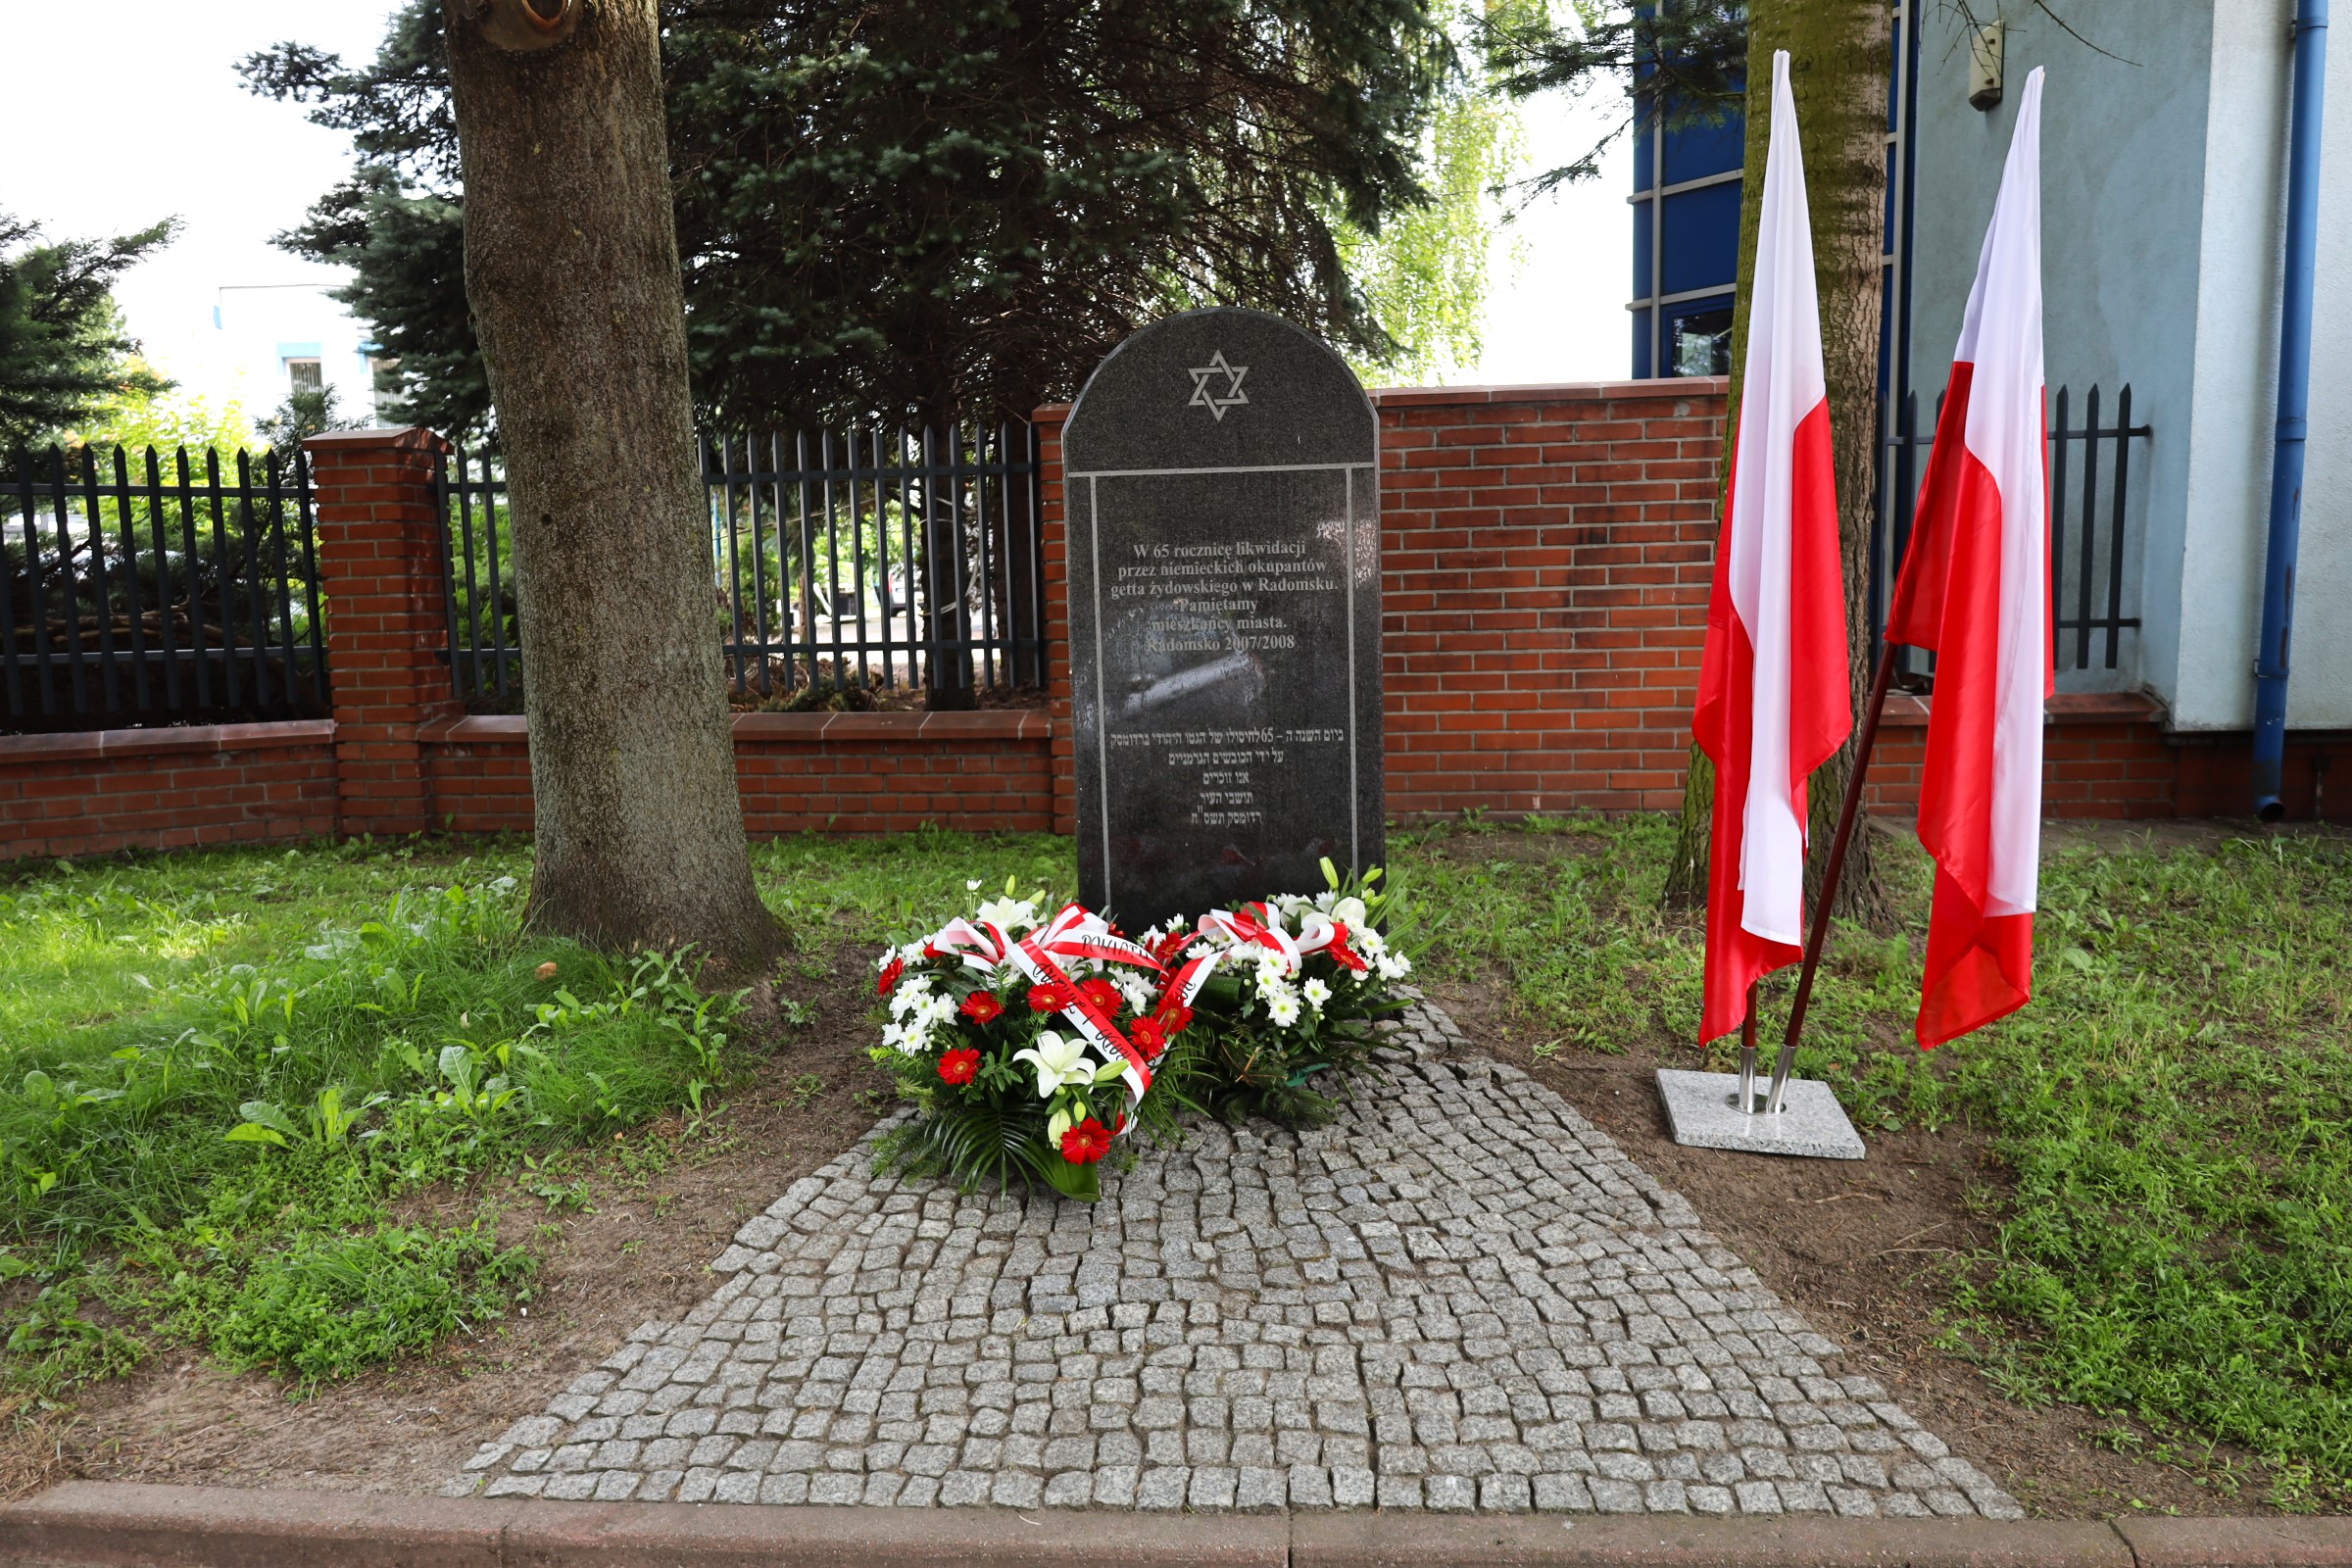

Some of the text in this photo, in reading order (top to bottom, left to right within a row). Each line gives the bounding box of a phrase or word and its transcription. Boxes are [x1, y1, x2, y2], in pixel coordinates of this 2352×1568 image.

[1133, 540, 1306, 560] W 65 rocznicę likwidacji
[1118, 558, 1326, 581] przez niemieckich okupantów
[1110, 576, 1339, 600] getta żydowskiego w Radomsku.
[1179, 597, 1258, 614] Pamiętamy
[1152, 613, 1288, 634] mieszkańcy miasta.
[1149, 634, 1296, 652] Radomsko 2007/2008
[1110, 733, 1151, 751] ברדומסק
[1152, 732, 1182, 746] היהודי
[1185, 731, 1206, 745] הגטו
[1207, 726, 1223, 745] של
[1295, 729, 1321, 743] השנה
[1323, 728, 1345, 742] ביום
[1168, 746, 1284, 765] על ידי הכובשים הגרמניים
[1202, 770, 1250, 785] אנו זוכרים
[1200, 792, 1253, 805] תושבי העיר
[1227, 811, 1262, 829] רדומסק
